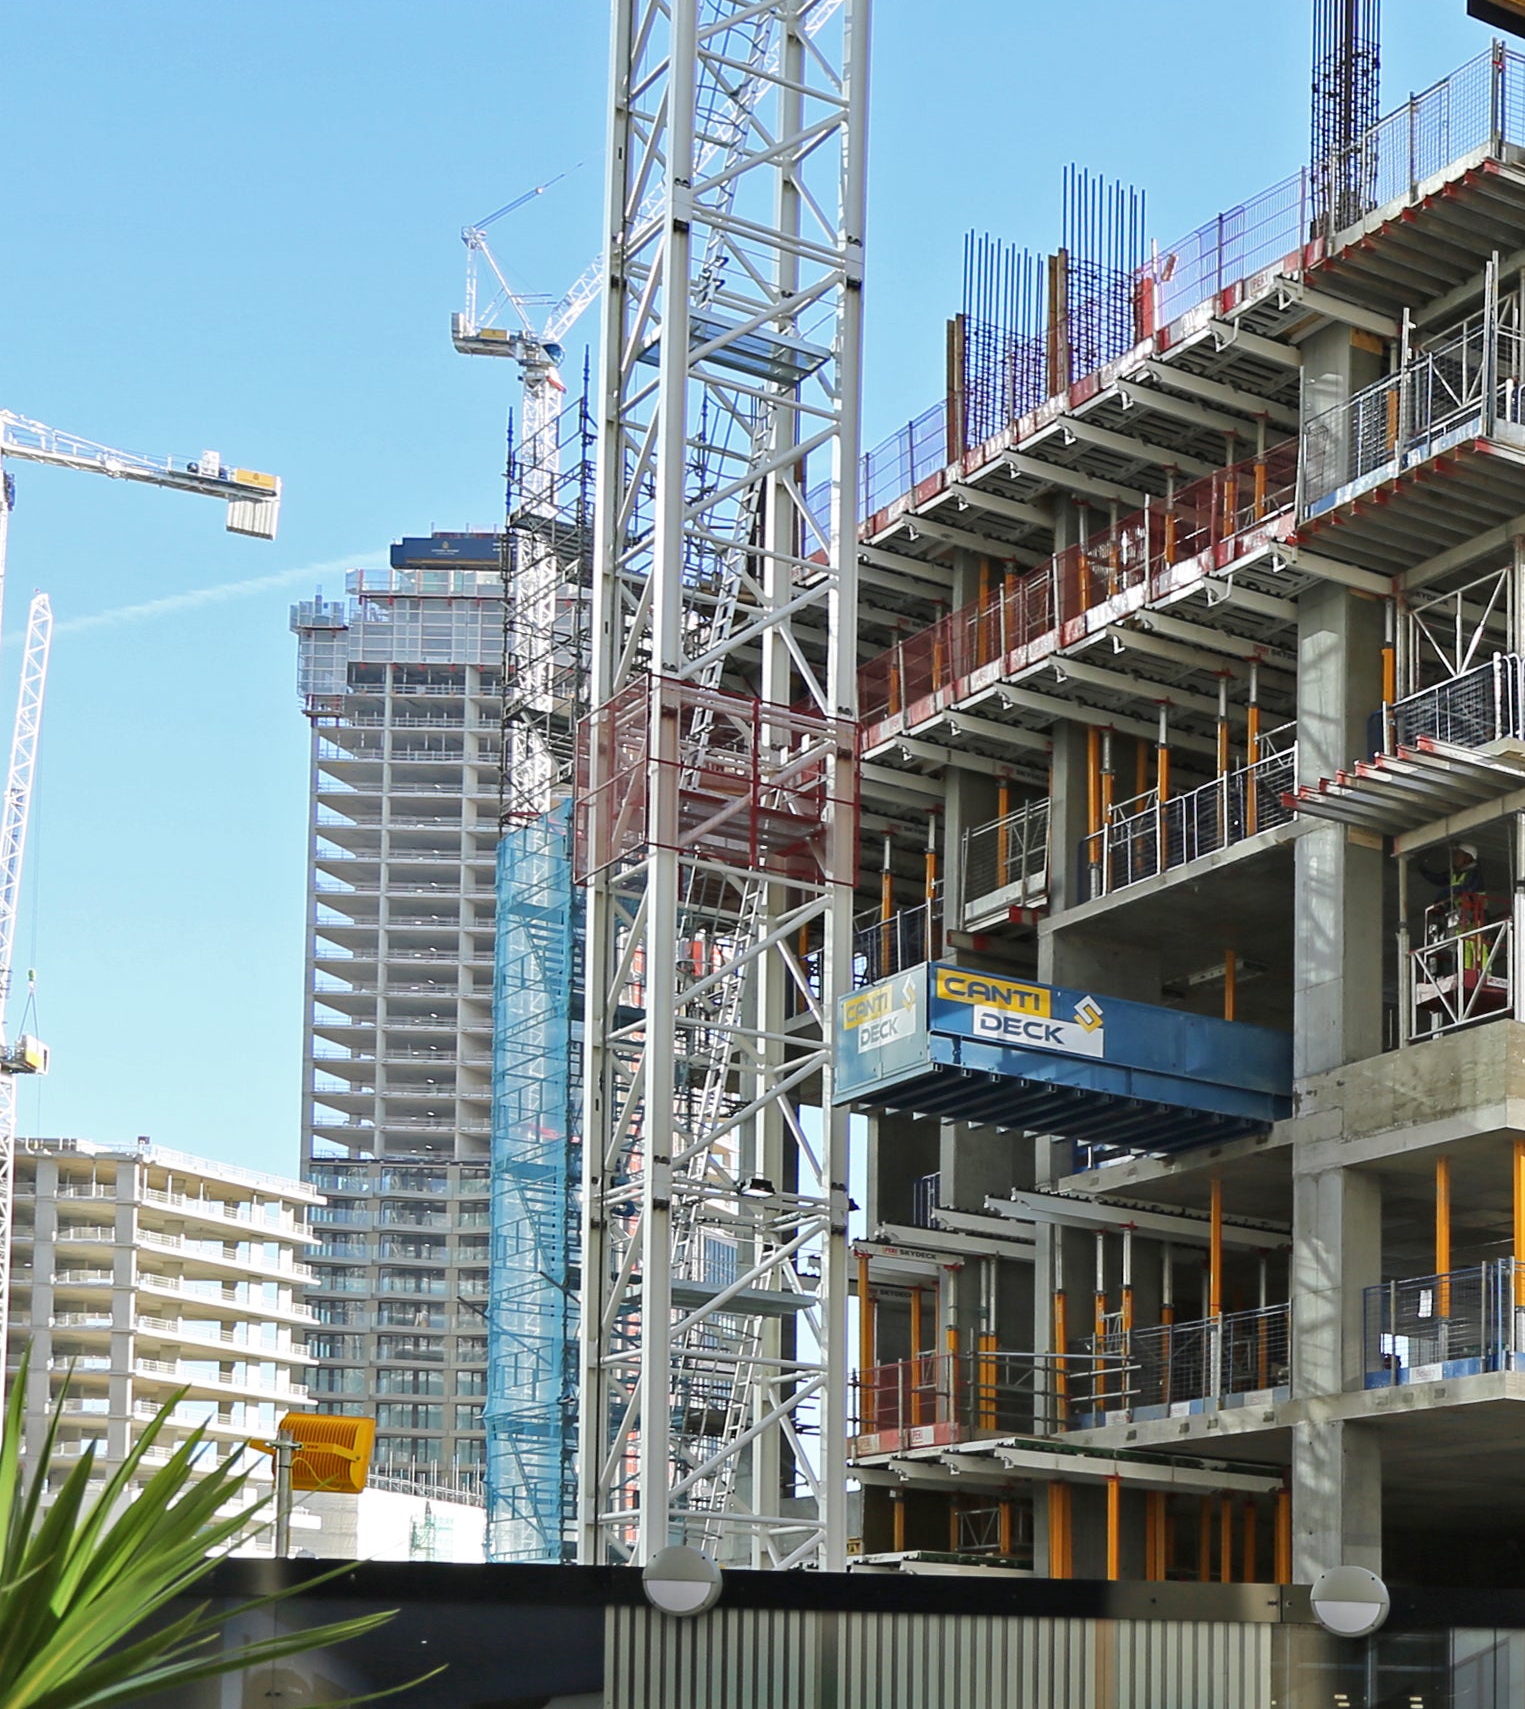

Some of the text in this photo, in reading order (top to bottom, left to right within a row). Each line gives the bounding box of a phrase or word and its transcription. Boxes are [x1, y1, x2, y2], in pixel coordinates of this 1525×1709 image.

[846, 994, 889, 1022] CANTI
[944, 976, 1040, 1011] CANTI
[861, 1018, 900, 1048] DECK
[981, 1012, 1065, 1046] DECK
[900, 1248, 937, 1261] SKYDECK
